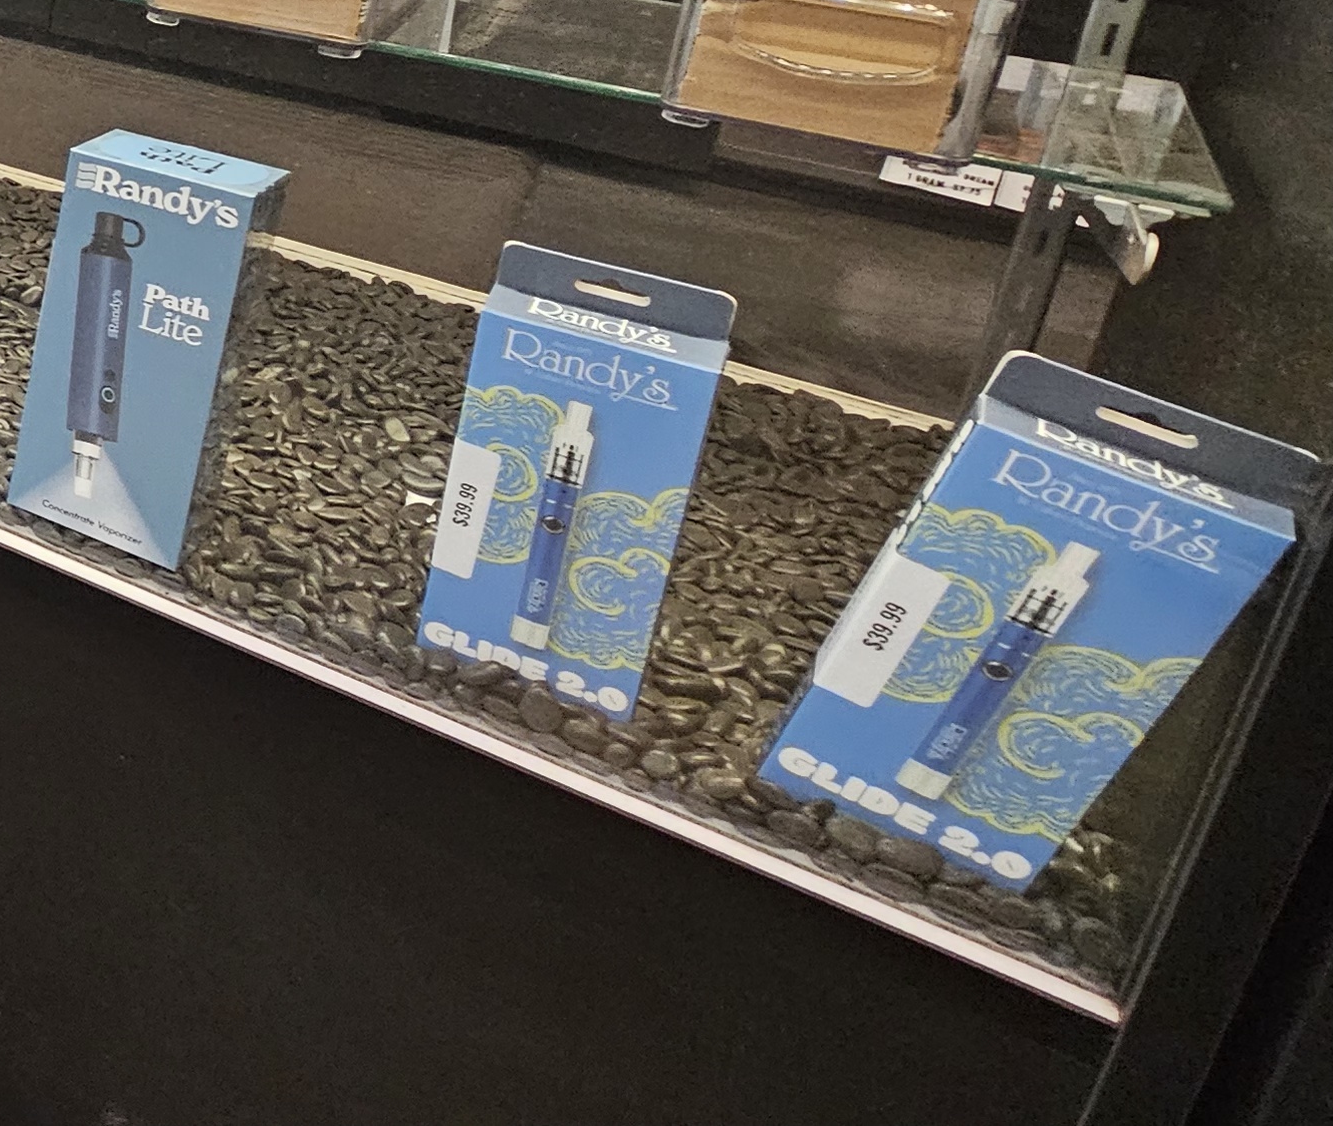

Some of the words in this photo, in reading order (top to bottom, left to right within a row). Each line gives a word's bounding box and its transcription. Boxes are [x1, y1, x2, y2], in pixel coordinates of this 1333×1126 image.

[91, 165, 240, 229] Randy's
[108, 288, 123, 332] Randy's
[138, 303, 203, 346] Lite
[143, 282, 210, 322] Path
[528, 295, 677, 353] Randy's
[501, 327, 679, 412] Randy's
[1036, 417, 1235, 508] Randy's
[41, 498, 96, 530] Concentrate
[98, 520, 143, 547] Vaporizer
[454, 482, 479, 527] $39.99
[991, 448, 1222, 574] Randy's
[862, 601, 908, 652] $39.99
[423, 620, 550, 682] GLIDE
[555, 670, 629, 713] 2.0
[778, 747, 937, 836] GLIDE
[938, 825, 1034, 882] 2.0
